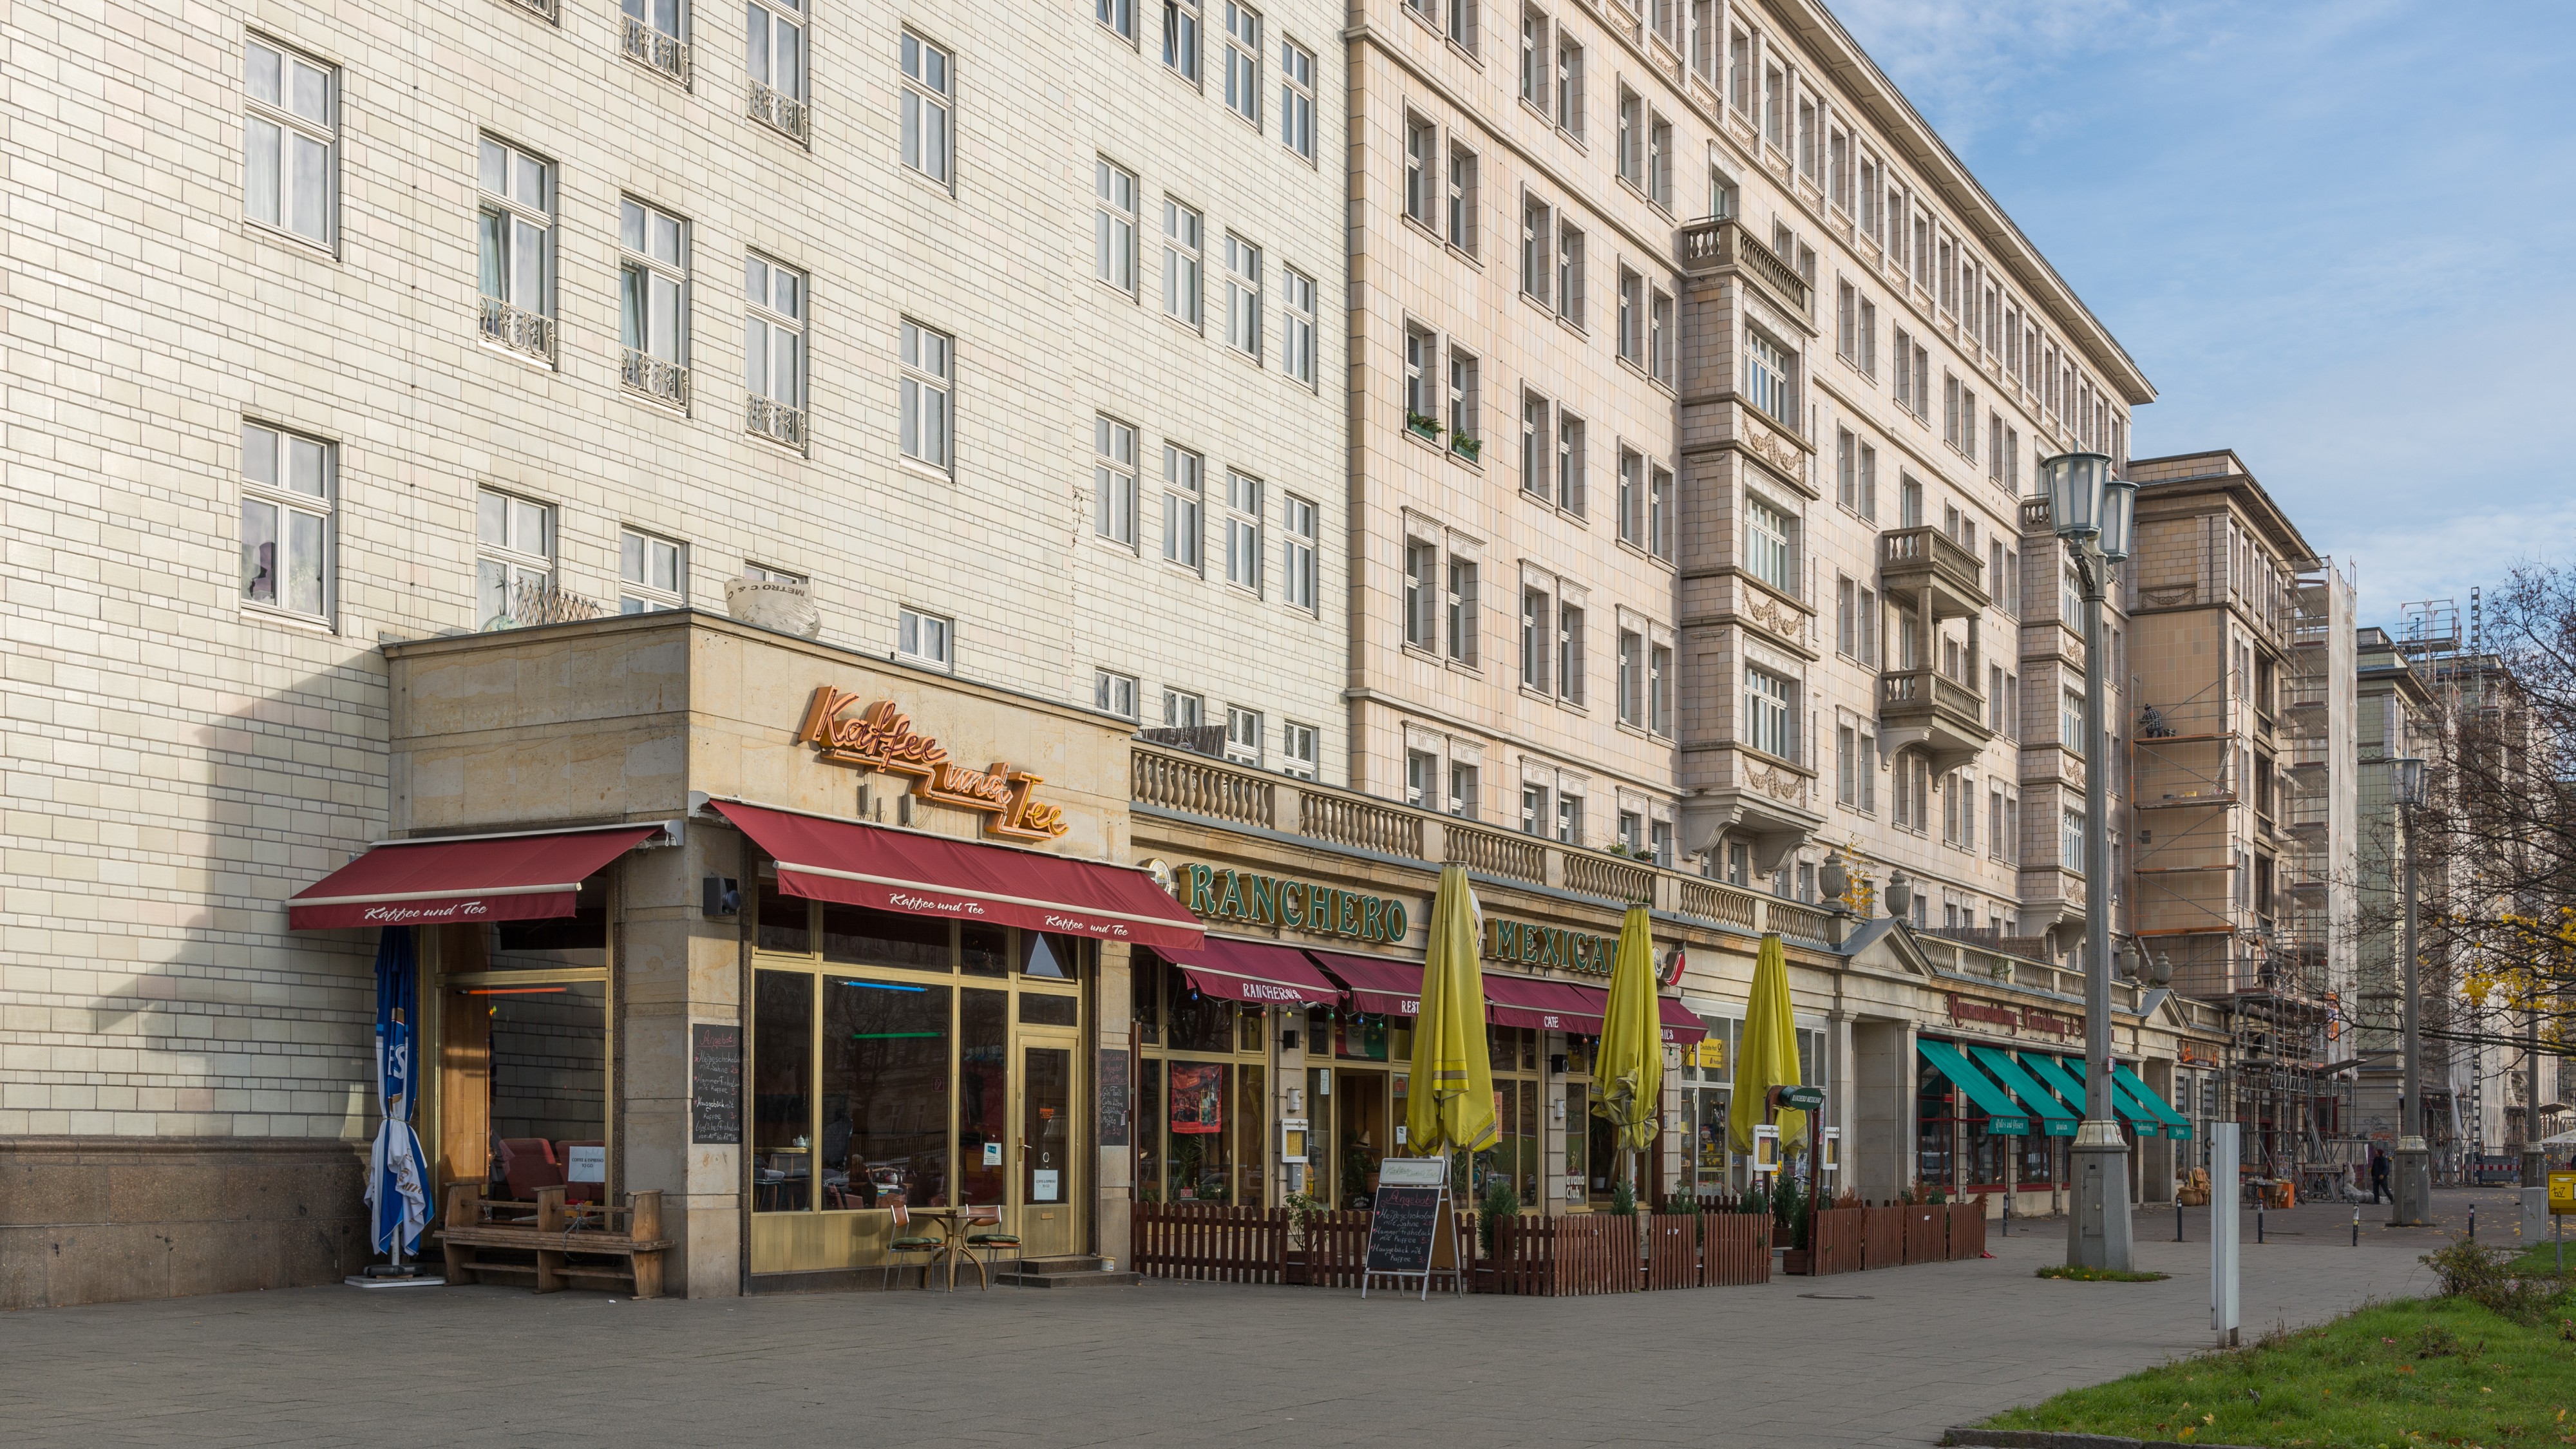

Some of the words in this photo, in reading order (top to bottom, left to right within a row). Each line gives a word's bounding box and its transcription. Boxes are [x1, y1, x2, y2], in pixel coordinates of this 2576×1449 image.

[800, 685, 948, 773] Kaffee
[939, 761, 1014, 805] und
[1009, 771, 1070, 837] Tee
[365, 907, 421, 922] Kaffee
[423, 904, 458, 916] und
[460, 901, 488, 914] Tee
[889, 893, 936, 911] Kaffee
[937, 902, 962, 912] und
[965, 903, 985, 914] Tee
[1189, 862, 1408, 943] RANCHERO
[1045, 915, 1084, 931] Kaffee
[1090, 923, 1110, 933] und
[1112, 924, 1129, 936] Tee
[1566, 1186, 1580, 1198] Club
